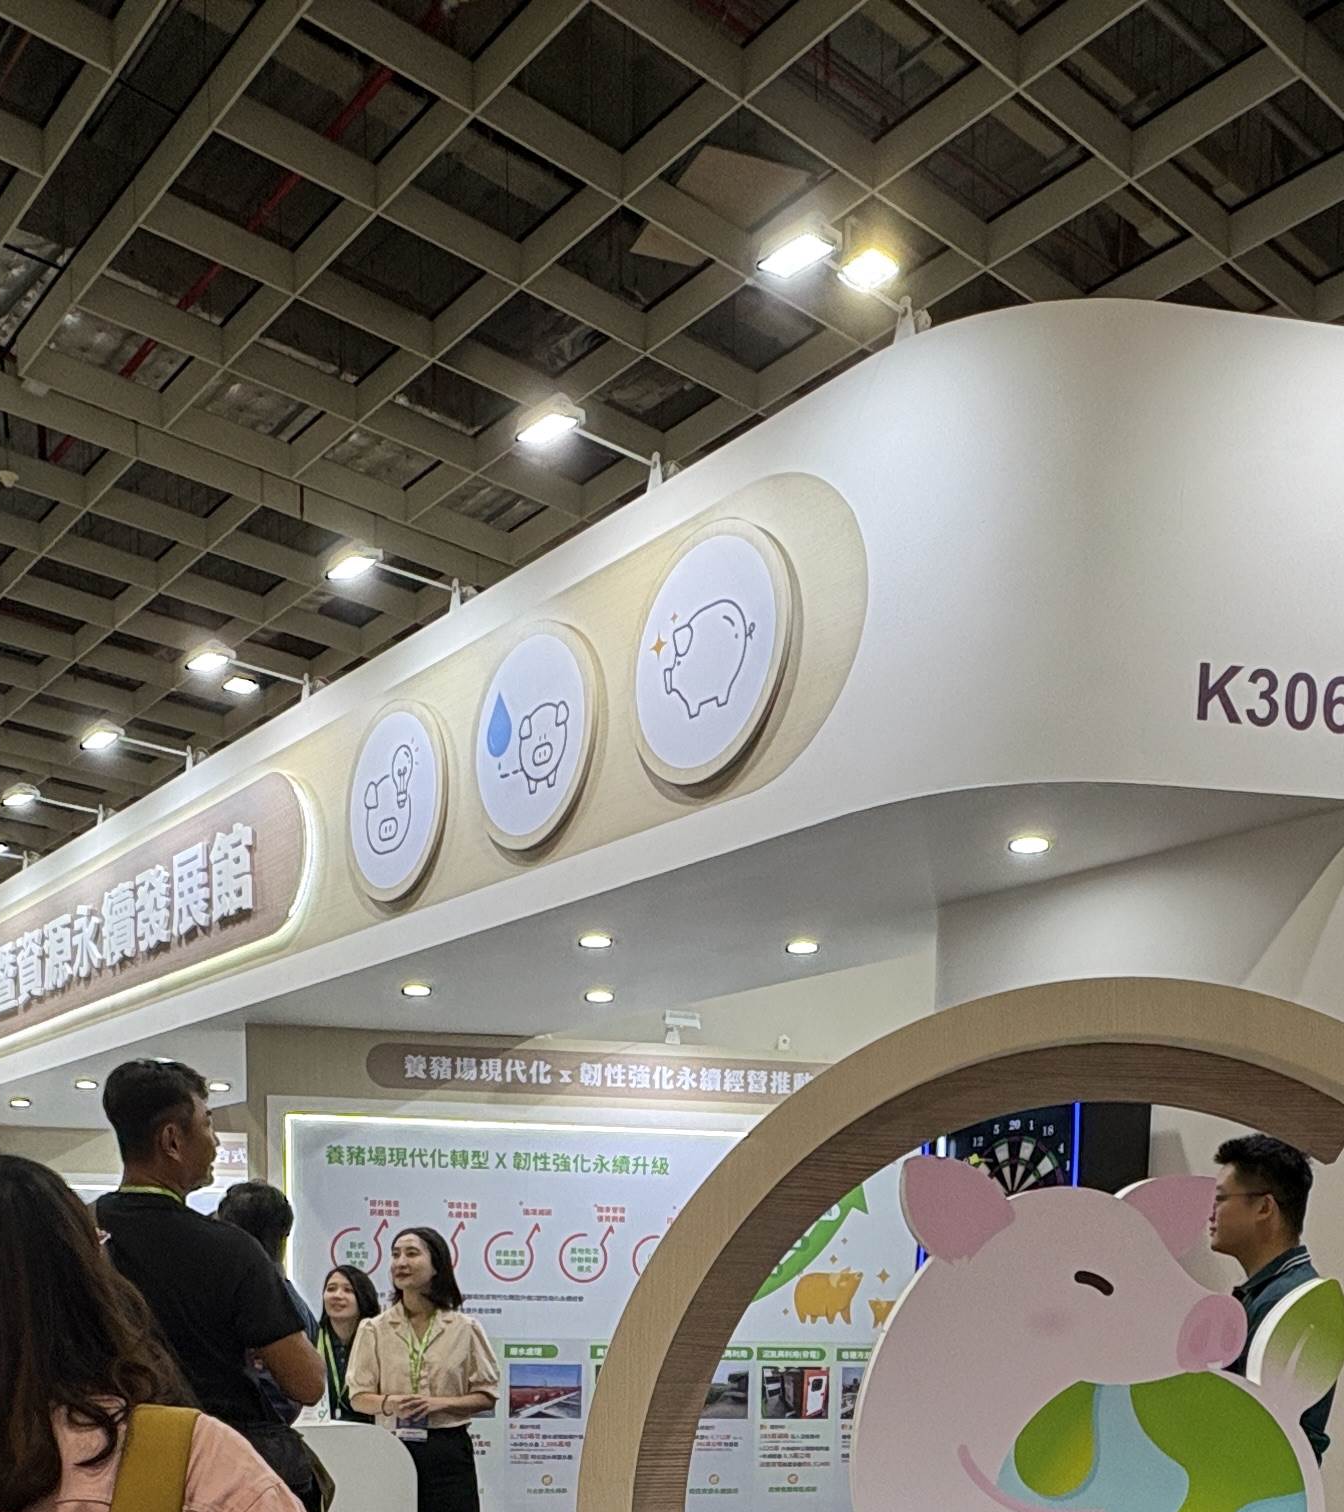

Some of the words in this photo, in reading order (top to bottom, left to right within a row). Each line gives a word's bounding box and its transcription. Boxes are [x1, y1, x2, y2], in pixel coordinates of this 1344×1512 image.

[403, 1054, 552, 1084] 養豬場現代化
[325, 1144, 489, 1169] 養豬場現代化轉型
[494, 1152, 507, 1169] X
[513, 1151, 670, 1176] 韌性強化永續升級
